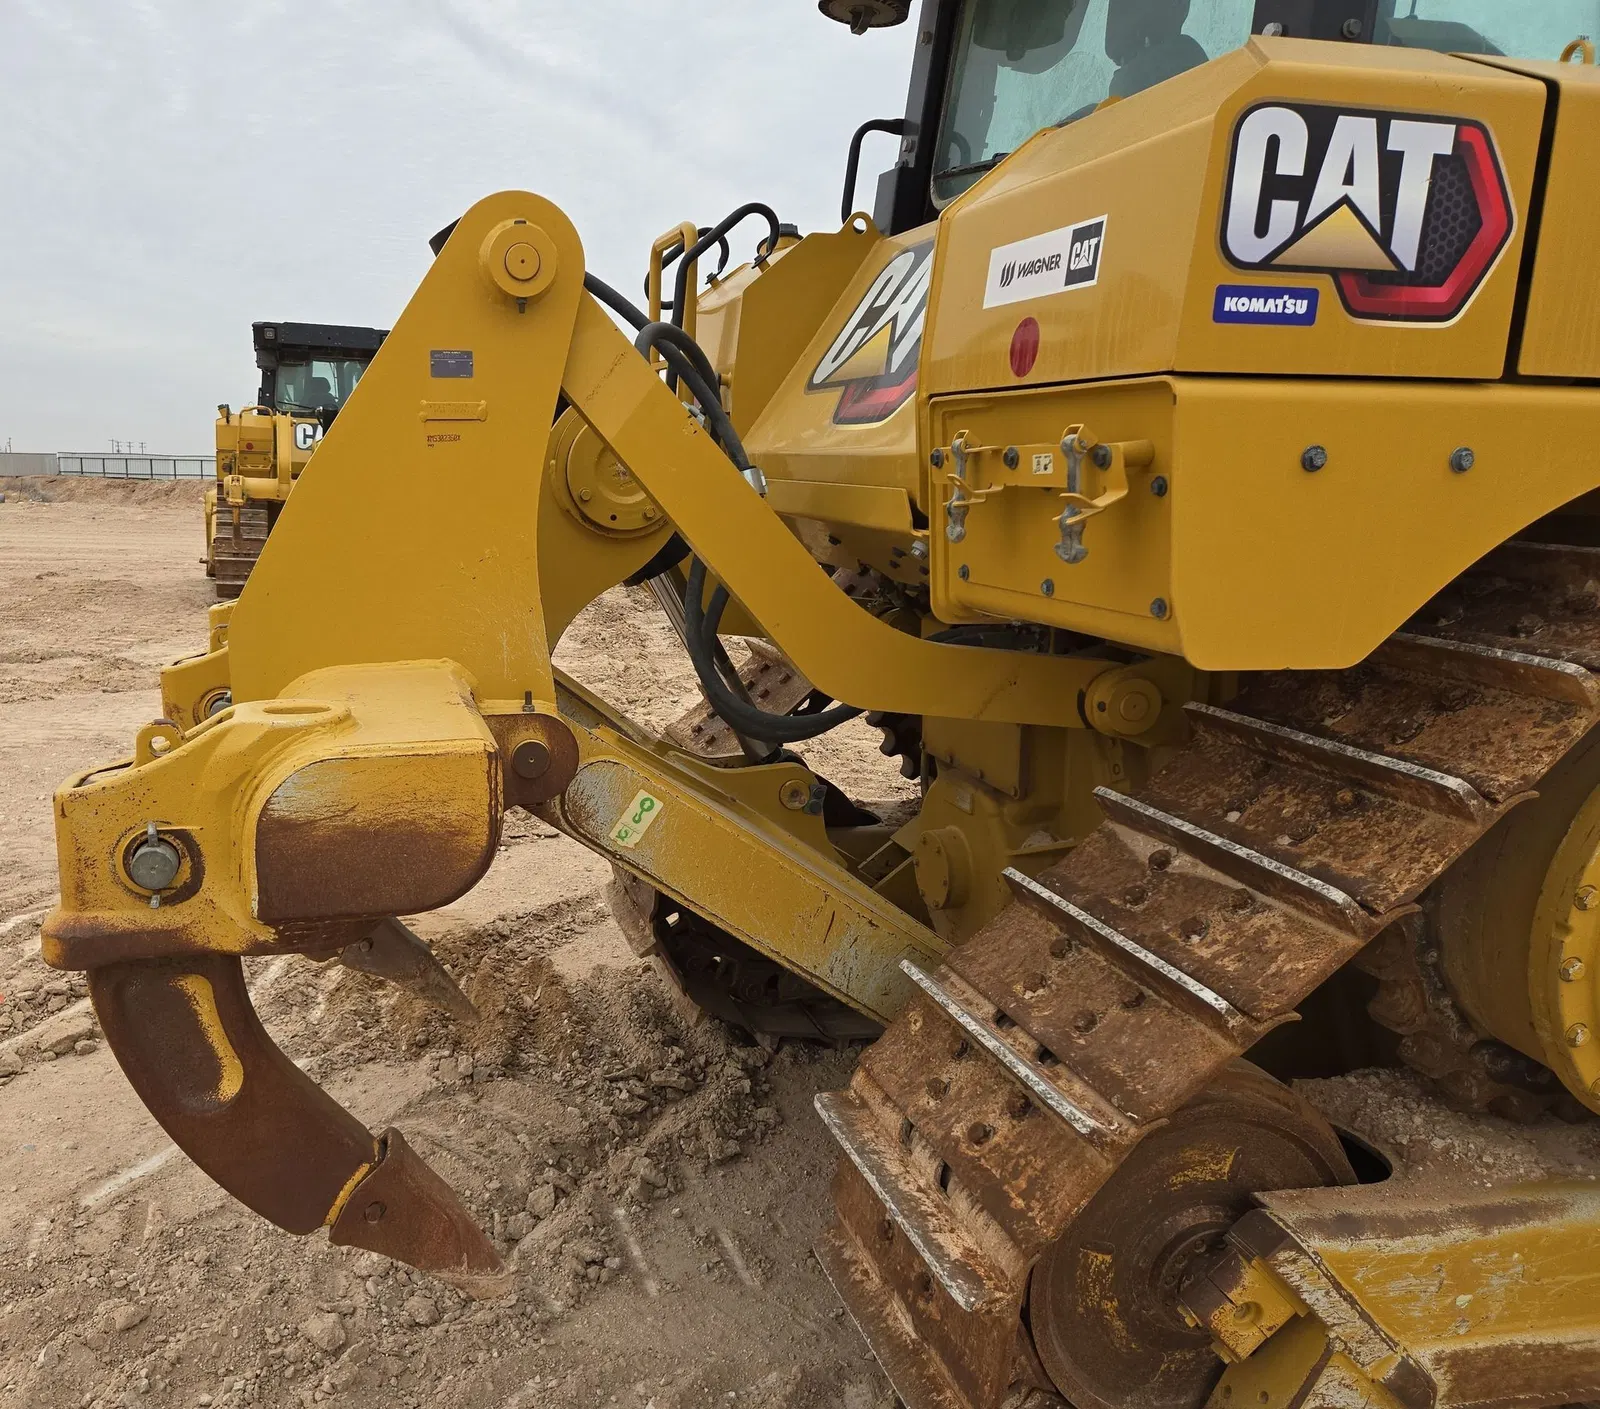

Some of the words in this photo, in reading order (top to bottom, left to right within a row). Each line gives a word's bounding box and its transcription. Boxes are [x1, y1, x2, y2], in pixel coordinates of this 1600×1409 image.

[1226, 106, 1457, 272] CAT
[1017, 253, 1062, 279] WAGNER
[1069, 237, 1099, 271] CAT
[1223, 294, 1309, 315] KOMATSU
